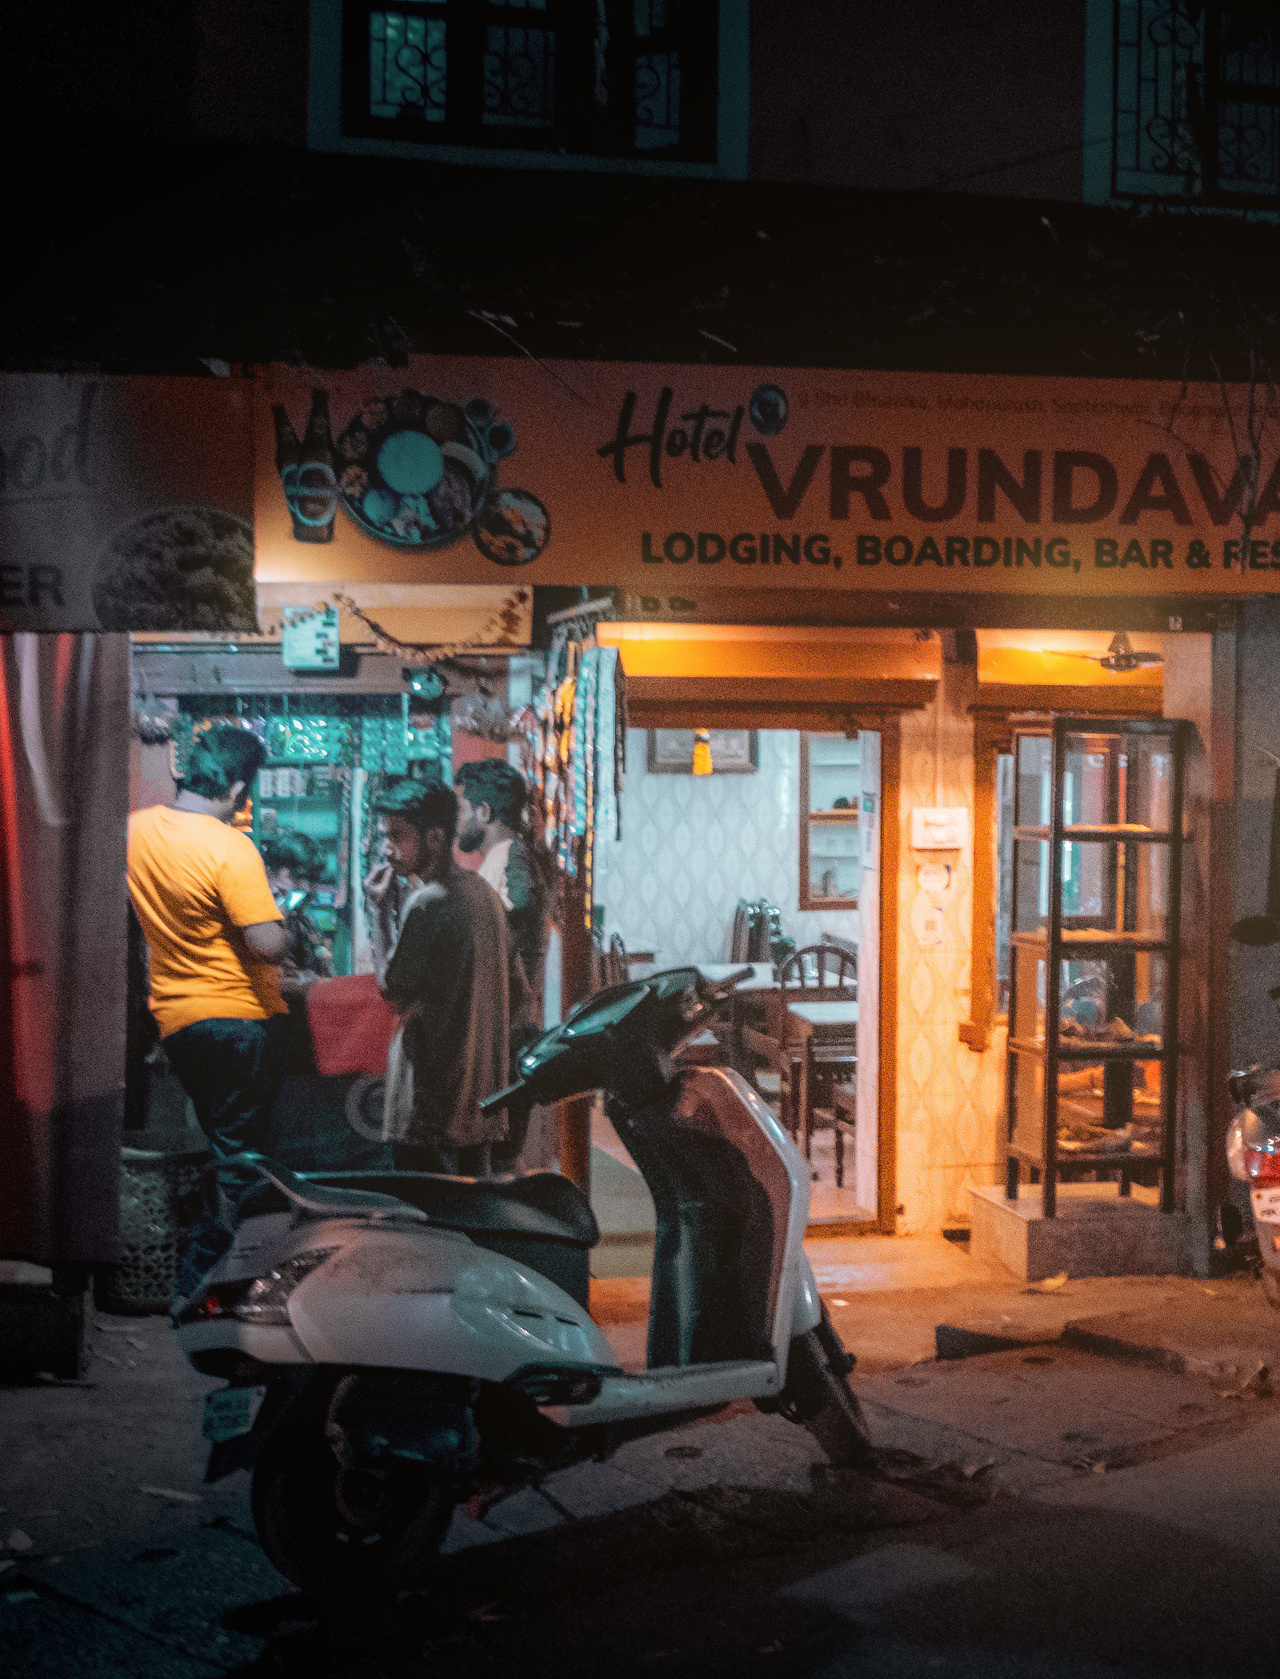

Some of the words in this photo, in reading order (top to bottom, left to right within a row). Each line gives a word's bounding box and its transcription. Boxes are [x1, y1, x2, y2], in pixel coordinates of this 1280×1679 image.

[0, 381, 99, 491] od
[597, 387, 745, 488] Hotel
[641, 532, 842, 571] LODGING,
[856, 534, 1082, 573] BOARDING,
[1094, 538, 1173, 570] BAR
[1186, 539, 1212, 570] &
